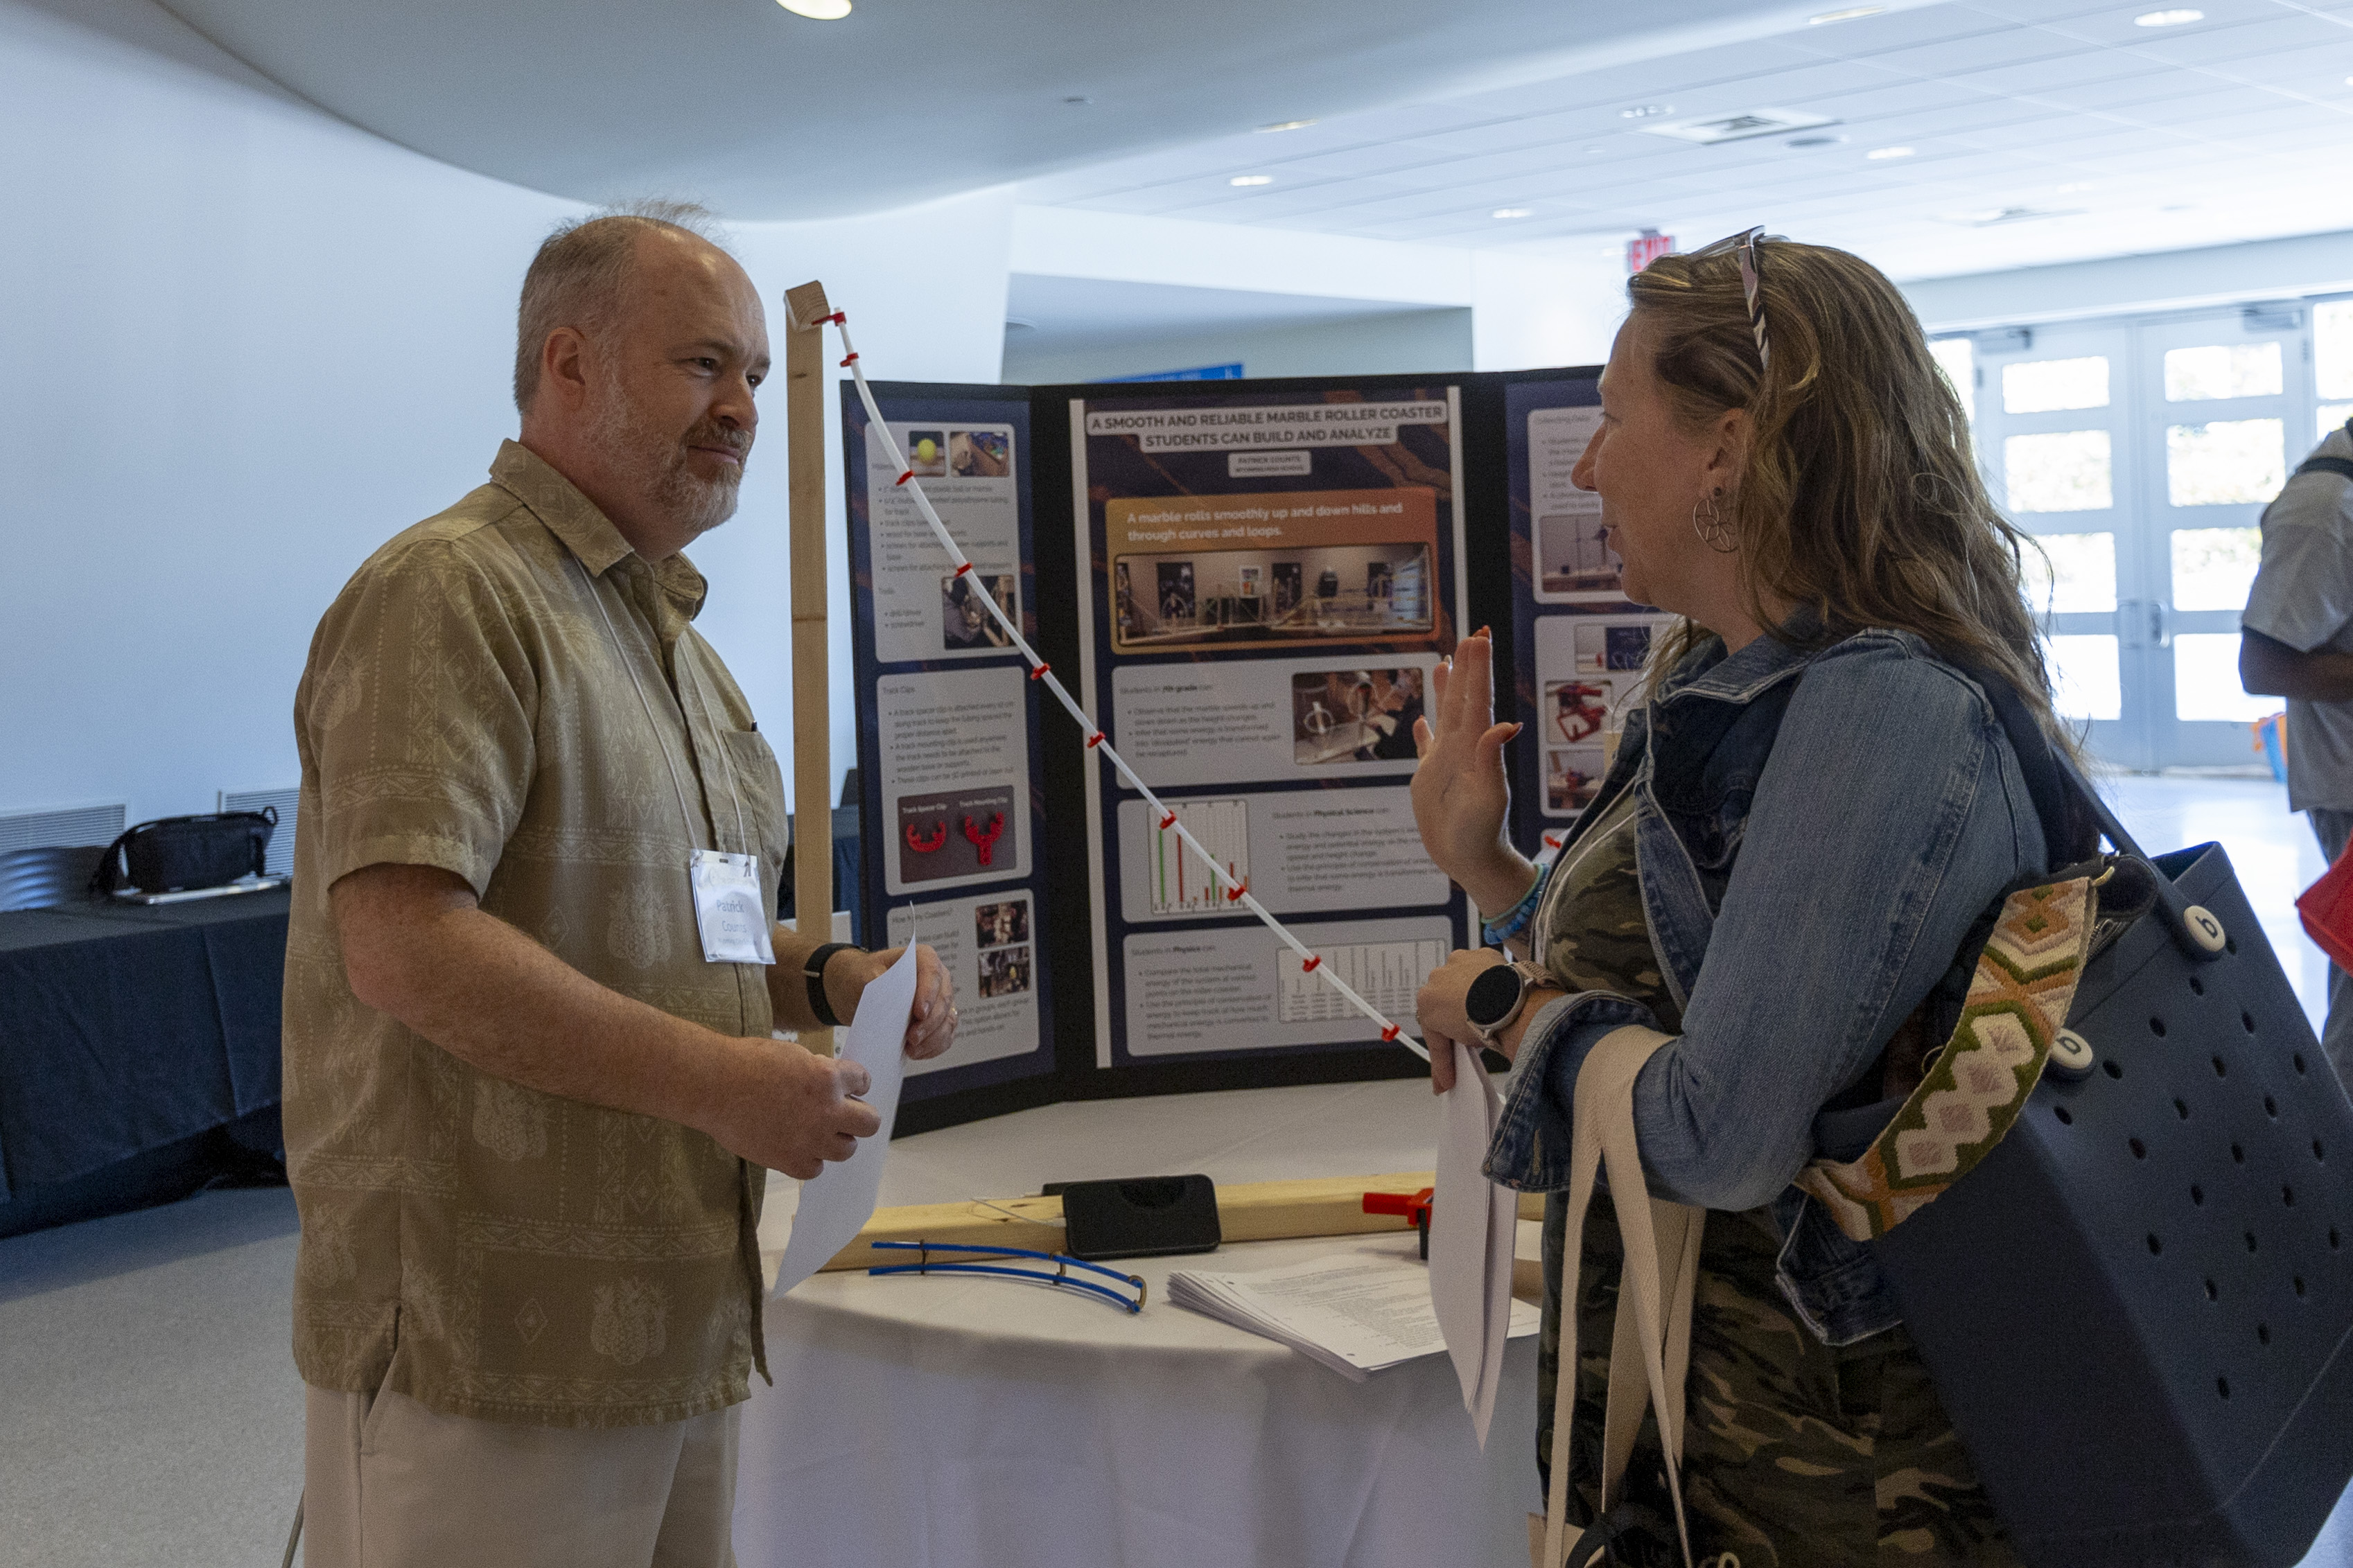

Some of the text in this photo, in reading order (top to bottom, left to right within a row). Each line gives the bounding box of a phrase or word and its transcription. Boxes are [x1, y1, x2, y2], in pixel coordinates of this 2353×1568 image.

[1091, 407, 1442, 430] A SMOOTH AND RELIABLE MARBLE ROLLER COASTER
[1145, 426, 1390, 448] STUDENTS CAN BUILD AND ANALYZE
[1126, 502, 1403, 524] A marble rolls smoothly up and down hills and
[1128, 529, 1176, 542] through
[1178, 527, 1219, 540] curves
[1221, 526, 1245, 538] and
[717, 899, 744, 913] Patrick
